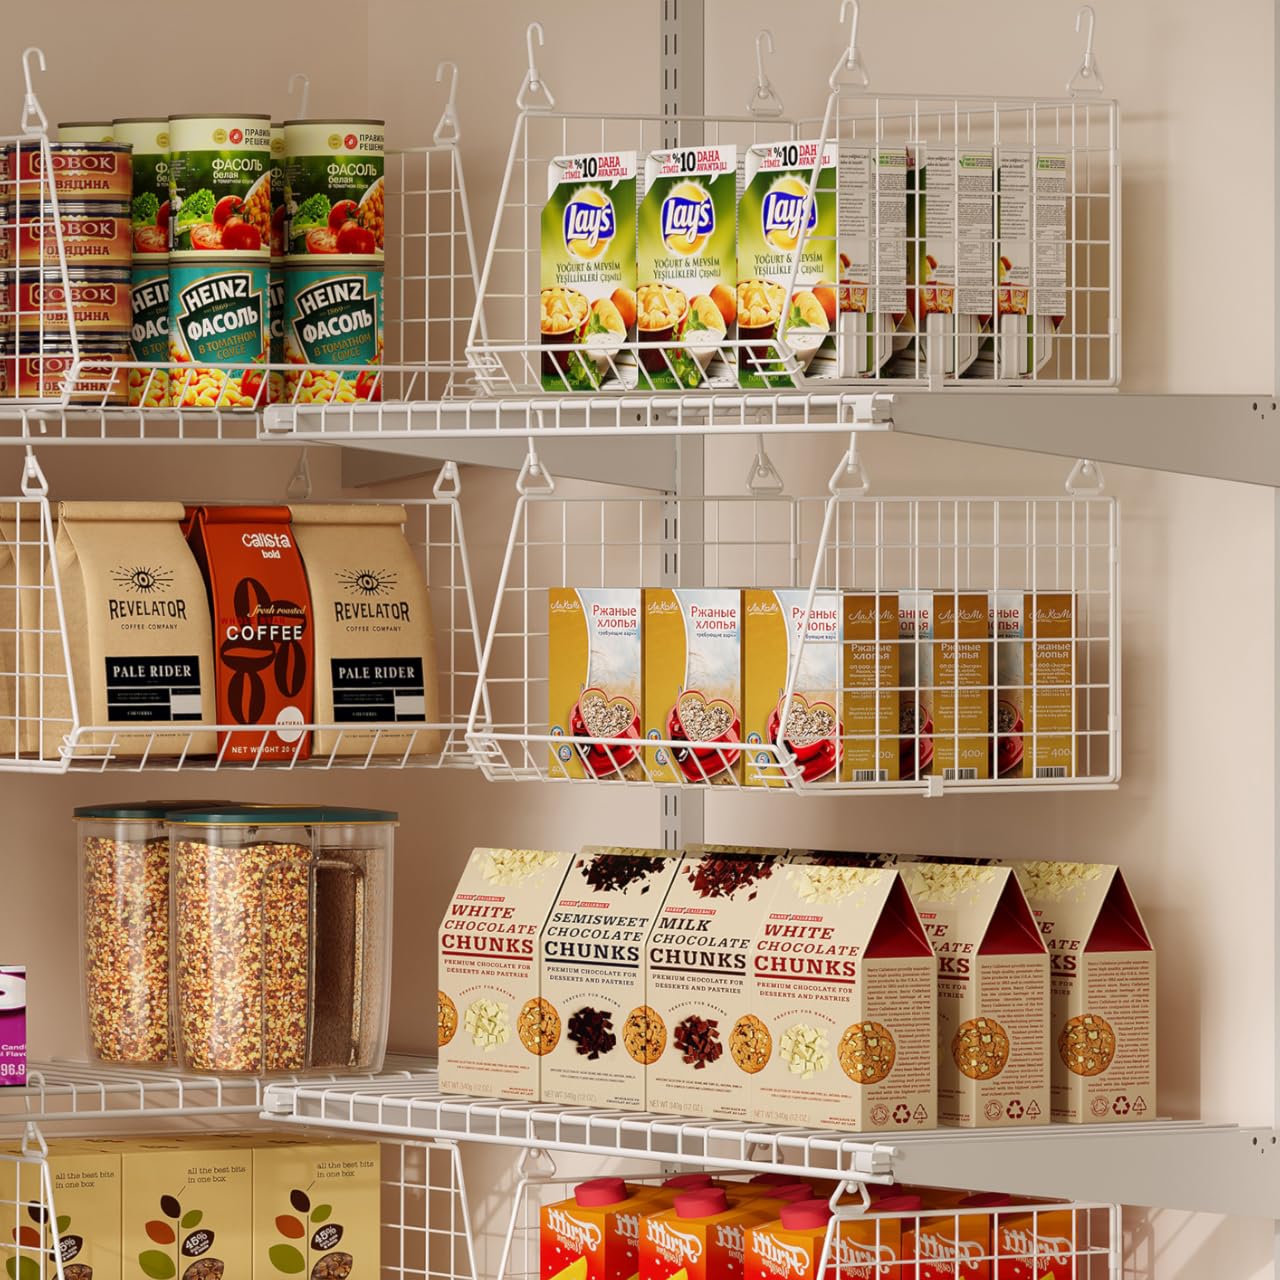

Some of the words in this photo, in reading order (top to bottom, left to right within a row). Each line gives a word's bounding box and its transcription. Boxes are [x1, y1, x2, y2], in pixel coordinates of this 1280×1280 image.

[697, 150, 720, 162] DAHA
[212, 158, 263, 171] ФАСОЛЬ
[327, 163, 377, 177] ФАСОЛЬ
[213, 170, 239, 180] белая
[567, 202, 612, 248] Lay's
[665, 196, 711, 243] Lay's
[654, 256, 683, 270] YOĞURT
[684, 258, 691, 268] &
[185, 278, 247, 311] HEINZ
[301, 281, 362, 314] HEINZ
[187, 306, 259, 341] ФАСОЛЬ
[302, 310, 372, 343] ФАСОЛЬ
[261, 549, 281, 559] bold
[109, 599, 187, 620] REVELATOR
[276, 605, 306, 615] roasted
[334, 601, 410, 623] REVELATOR
[592, 605, 637, 617] Ржаные
[691, 606, 736, 619] Ржаные
[597, 618, 637, 630] хлопья
[696, 619, 736, 630] хлопья
[226, 625, 303, 641] COFFEE
[113, 665, 146, 678] PALE
[150, 664, 192, 678] RIDER
[339, 667, 371, 679] PALE
[375, 666, 415, 679] RIDER
[451, 904, 516, 920] WHITE
[552, 912, 649, 928] SEMISWEET
[444, 919, 538, 935] CHOCOLATE
[658, 917, 712, 932] MILK
[764, 923, 835, 940] WHITE
[547, 926, 644, 943] CHOCOLATE
[652, 932, 751, 949] CHOCOLATE
[441, 934, 534, 955] CHUNKS
[544, 940, 640, 962] CHUNKS
[756, 940, 860, 957] CHOCOLATE
[650, 947, 747, 970] CHUNKS
[754, 954, 856, 977] CHUNKS
[756, 981, 792, 991] PREMIUM
[793, 984, 836, 993] CHOCOLATE
[759, 990, 795, 999] DESSERTS
[797, 992, 813, 1000] AND
[814, 994, 851, 1002] PASTRIES
